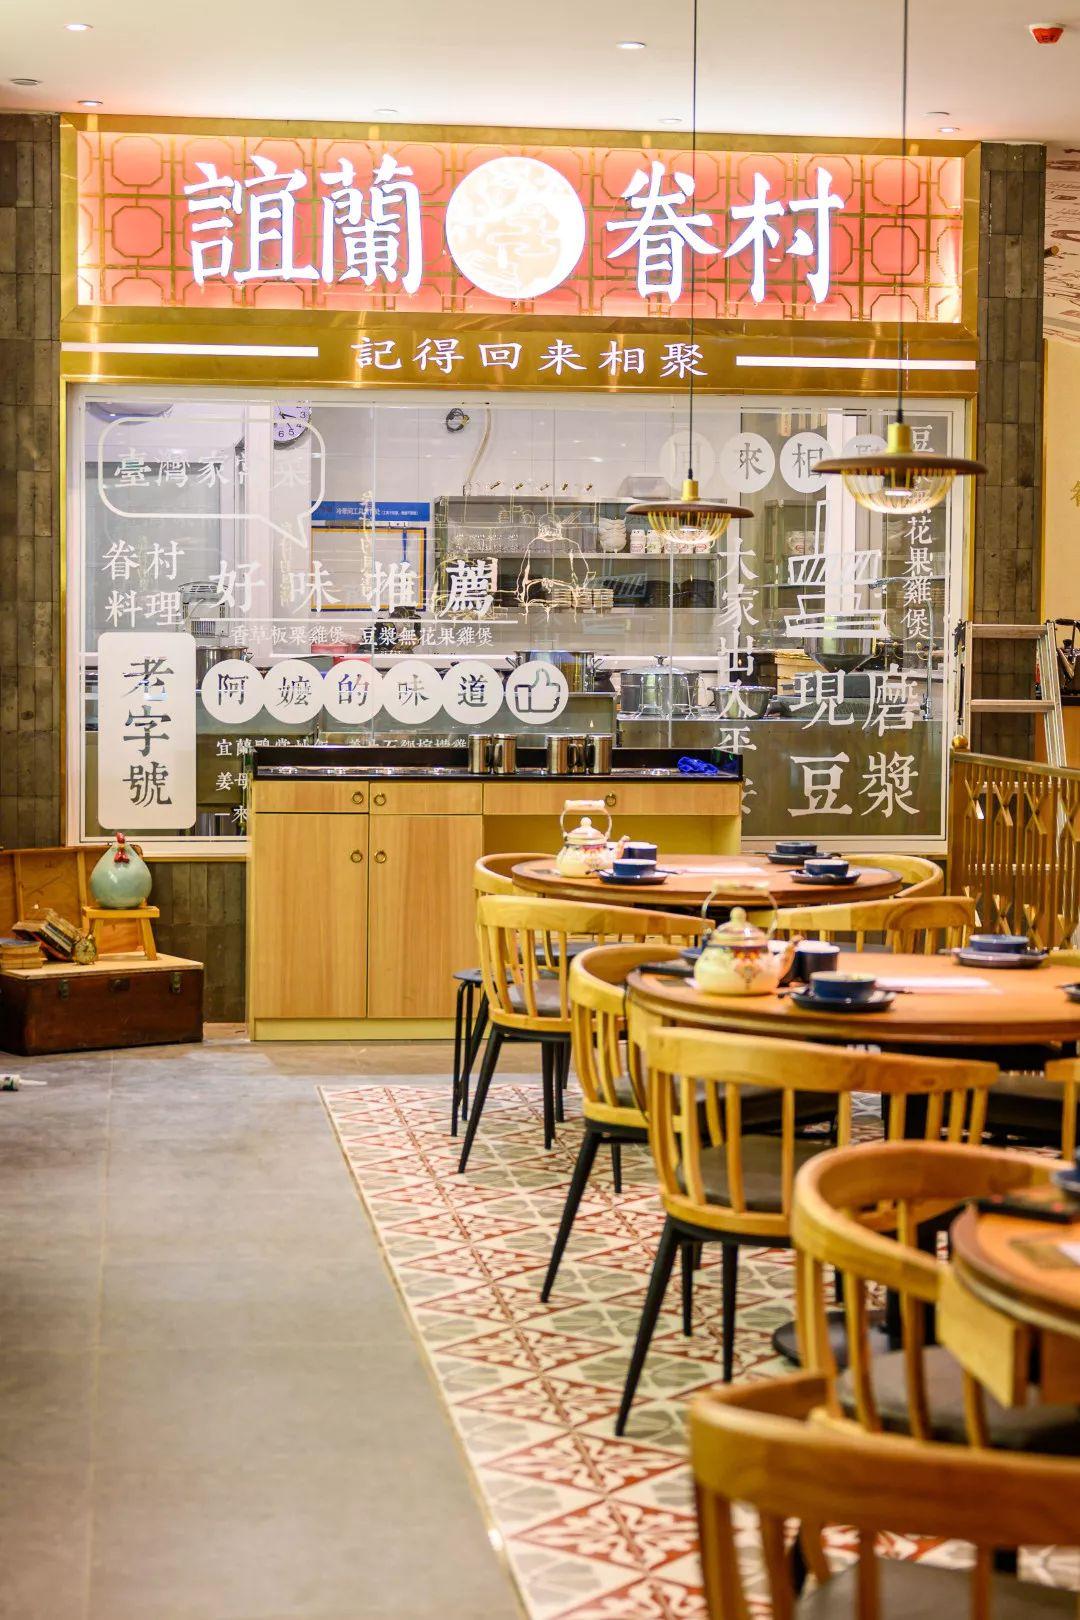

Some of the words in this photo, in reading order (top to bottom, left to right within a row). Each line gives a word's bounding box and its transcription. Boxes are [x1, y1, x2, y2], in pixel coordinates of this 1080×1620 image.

[184, 154, 422, 296] 誼蘭
[606, 161, 845, 305] 眷村
[102, 539, 185, 580] 眷村
[209, 560, 494, 617] 好味推薦
[105, 589, 185, 627] 料理
[218, 673, 488, 708] 阿嬤的味道
[789, 663, 919, 737] 現磨
[122, 656, 174, 808] 老字號
[787, 751, 921, 818] 豆漿
